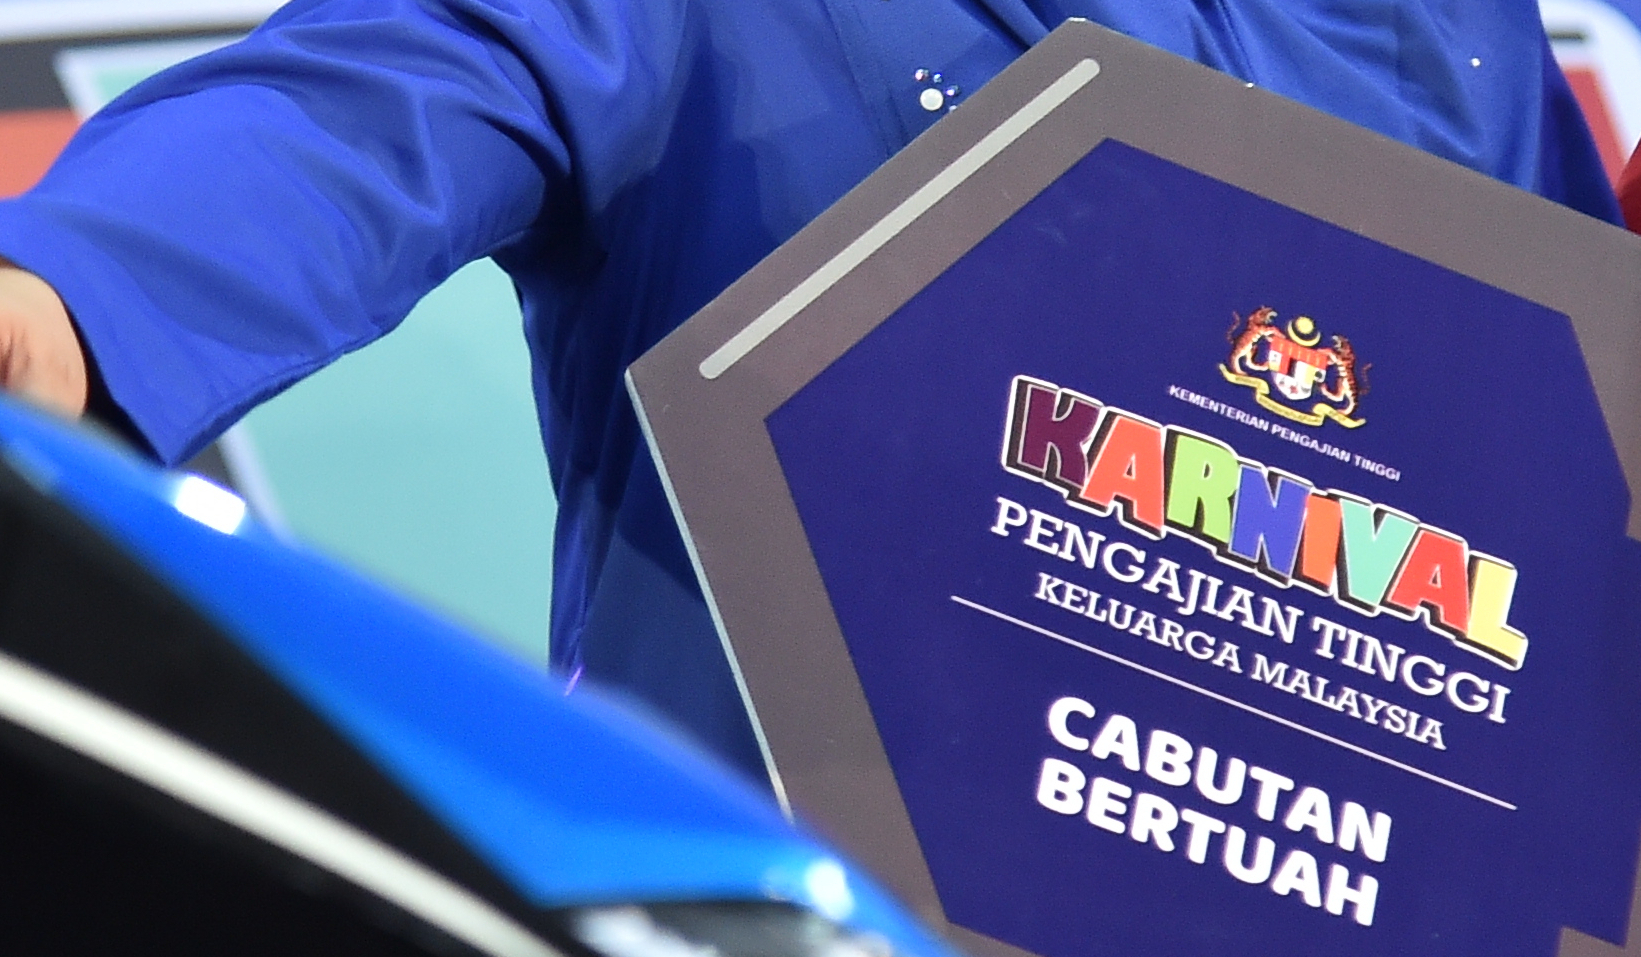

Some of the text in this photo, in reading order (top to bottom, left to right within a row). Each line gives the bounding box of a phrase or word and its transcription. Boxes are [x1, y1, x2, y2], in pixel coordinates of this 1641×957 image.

[1169, 384, 1270, 432] KEMENTERIAN
[1271, 423, 1351, 463] PENGAJIAN
[1354, 454, 1401, 483] TINGGI
[1002, 375, 1528, 670] KARNIVAL
[990, 496, 1511, 724] PENGAJIAN TINGGI
[1034, 572, 1447, 751] KELUARGA MALAYSIA
[1036, 757, 1379, 927] BERTUAH
[1048, 696, 1392, 863] CABUTAN
